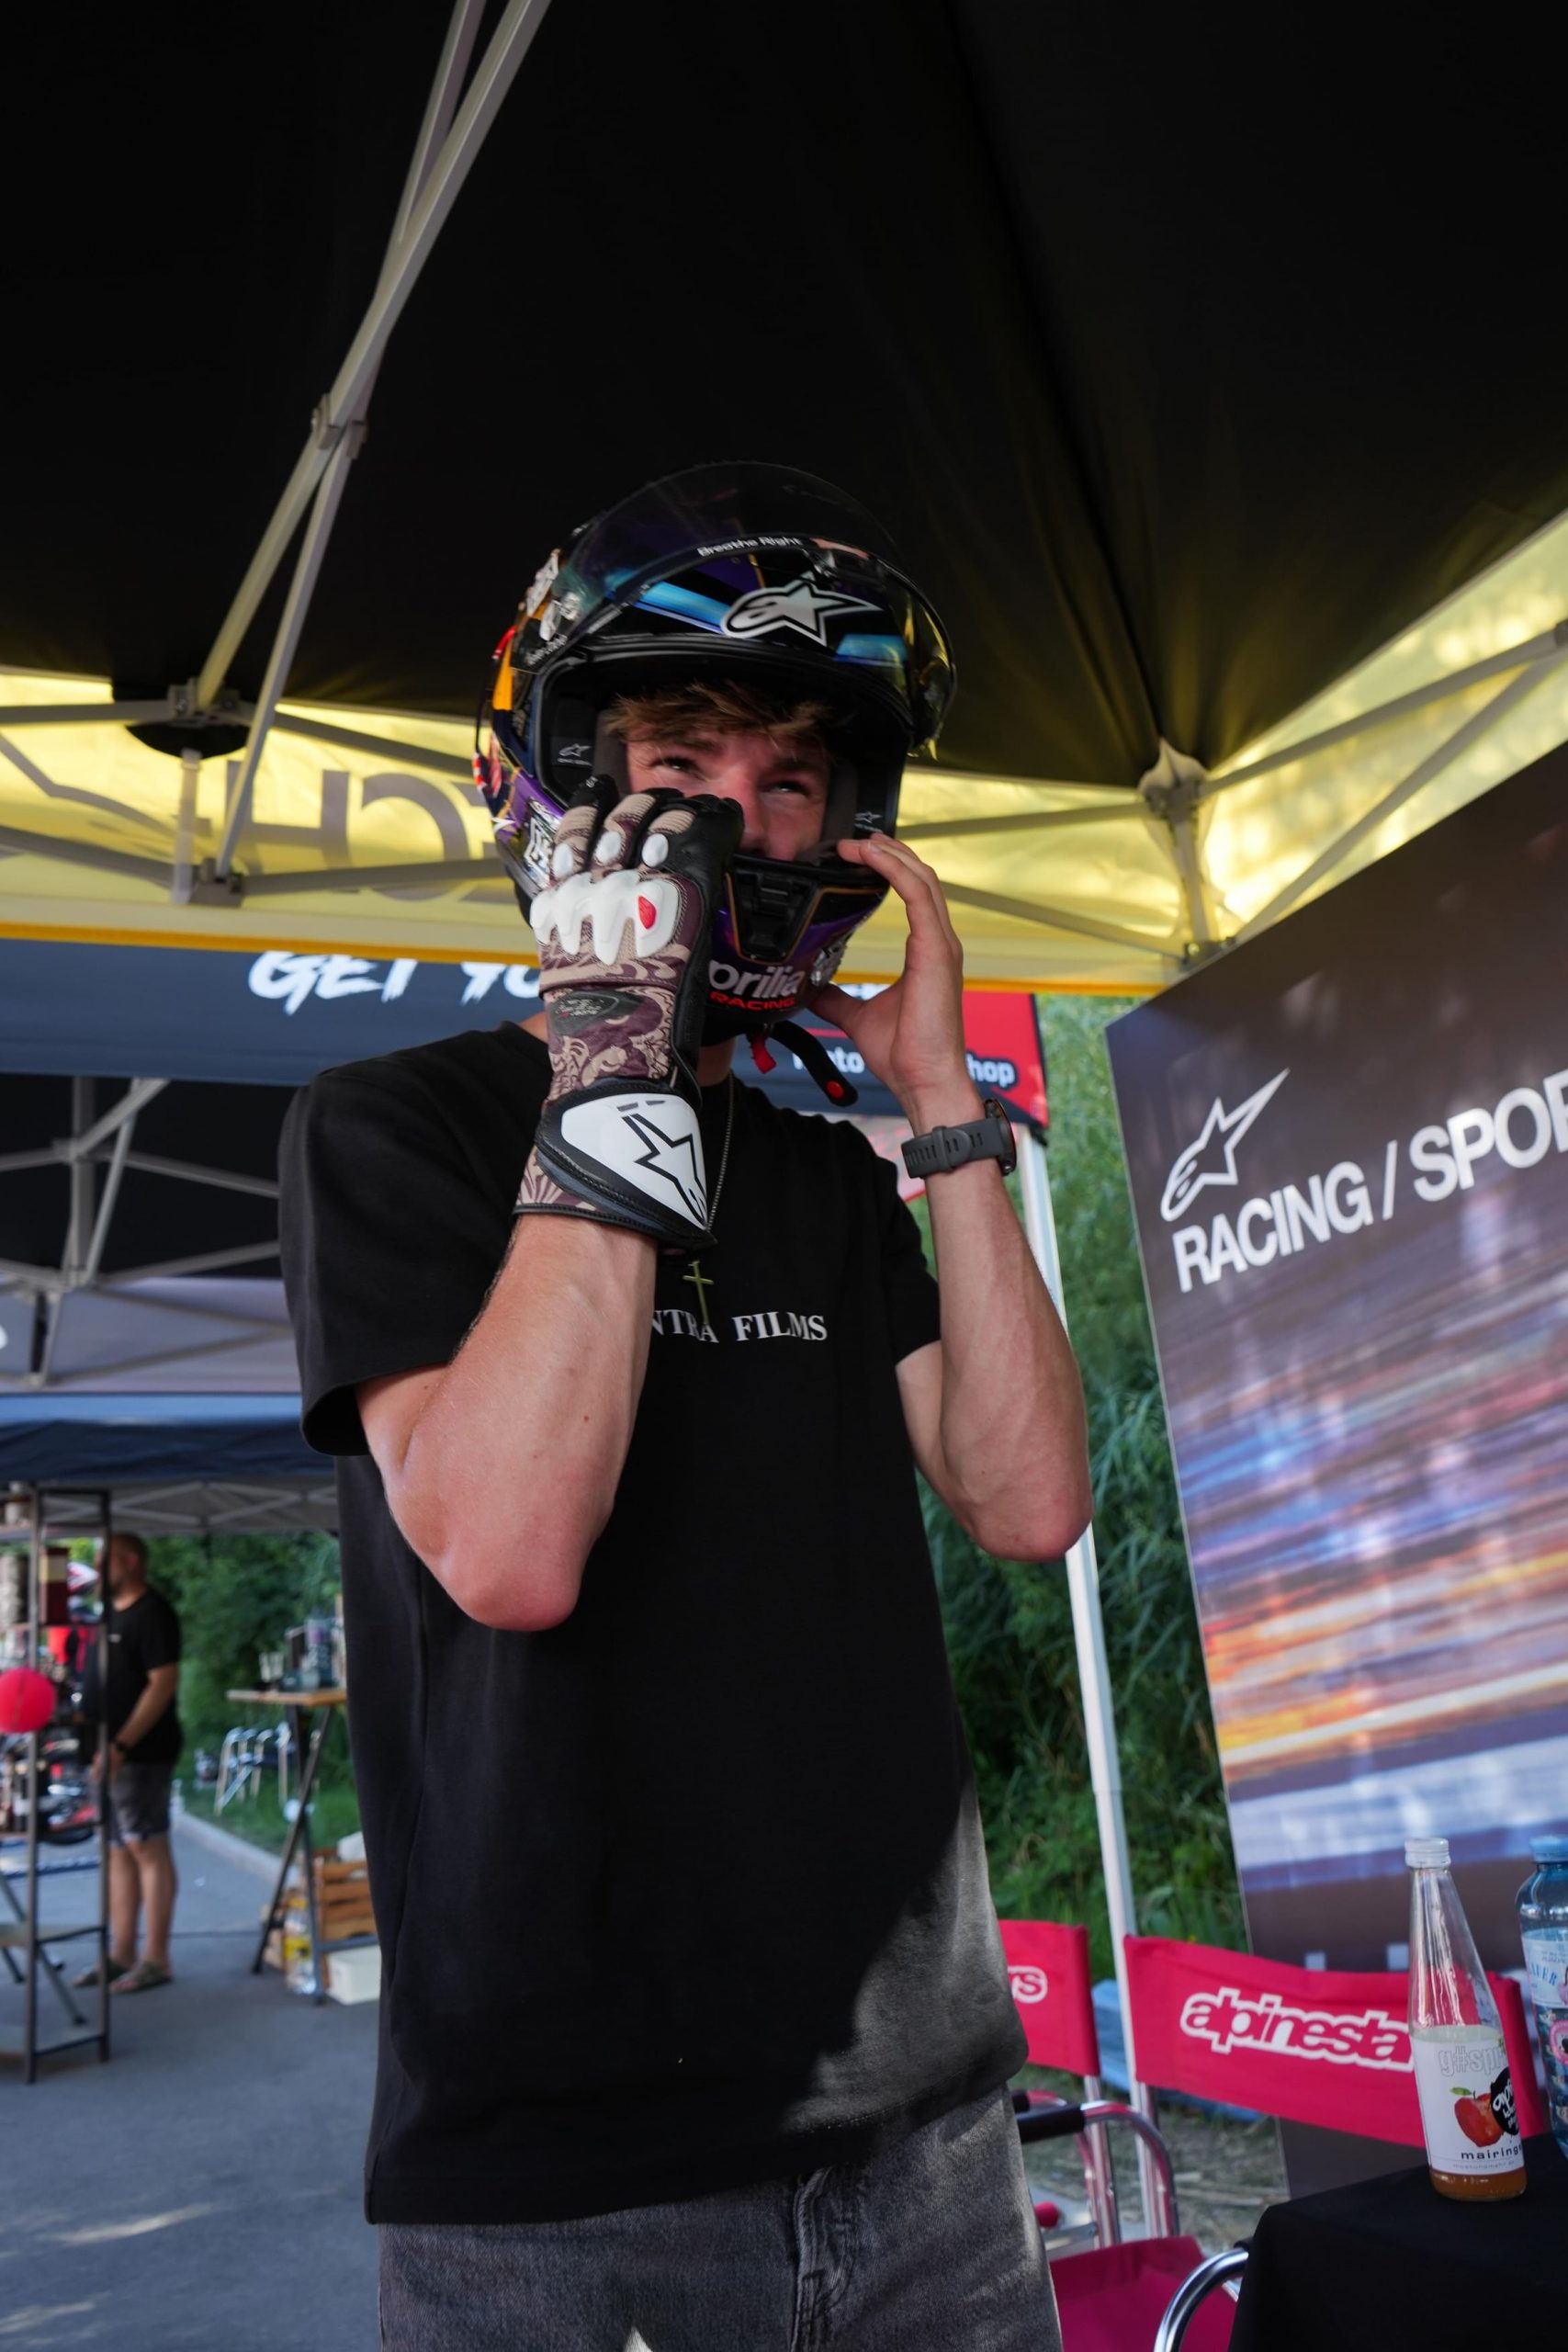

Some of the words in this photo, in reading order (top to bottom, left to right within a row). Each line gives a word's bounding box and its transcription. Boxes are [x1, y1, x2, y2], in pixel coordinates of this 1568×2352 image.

[697, 538, 759, 557] Breathe
[758, 537, 804, 546] Right
[708, 959, 806, 999] prilia
[708, 990, 795, 1011] RACING
[965, 1053, 1015, 1089] hop
[1172, 1161, 1374, 1293] RACING
[732, 1311, 828, 1342] FILMS
[1180, 1986, 1415, 2073] alpinesta
